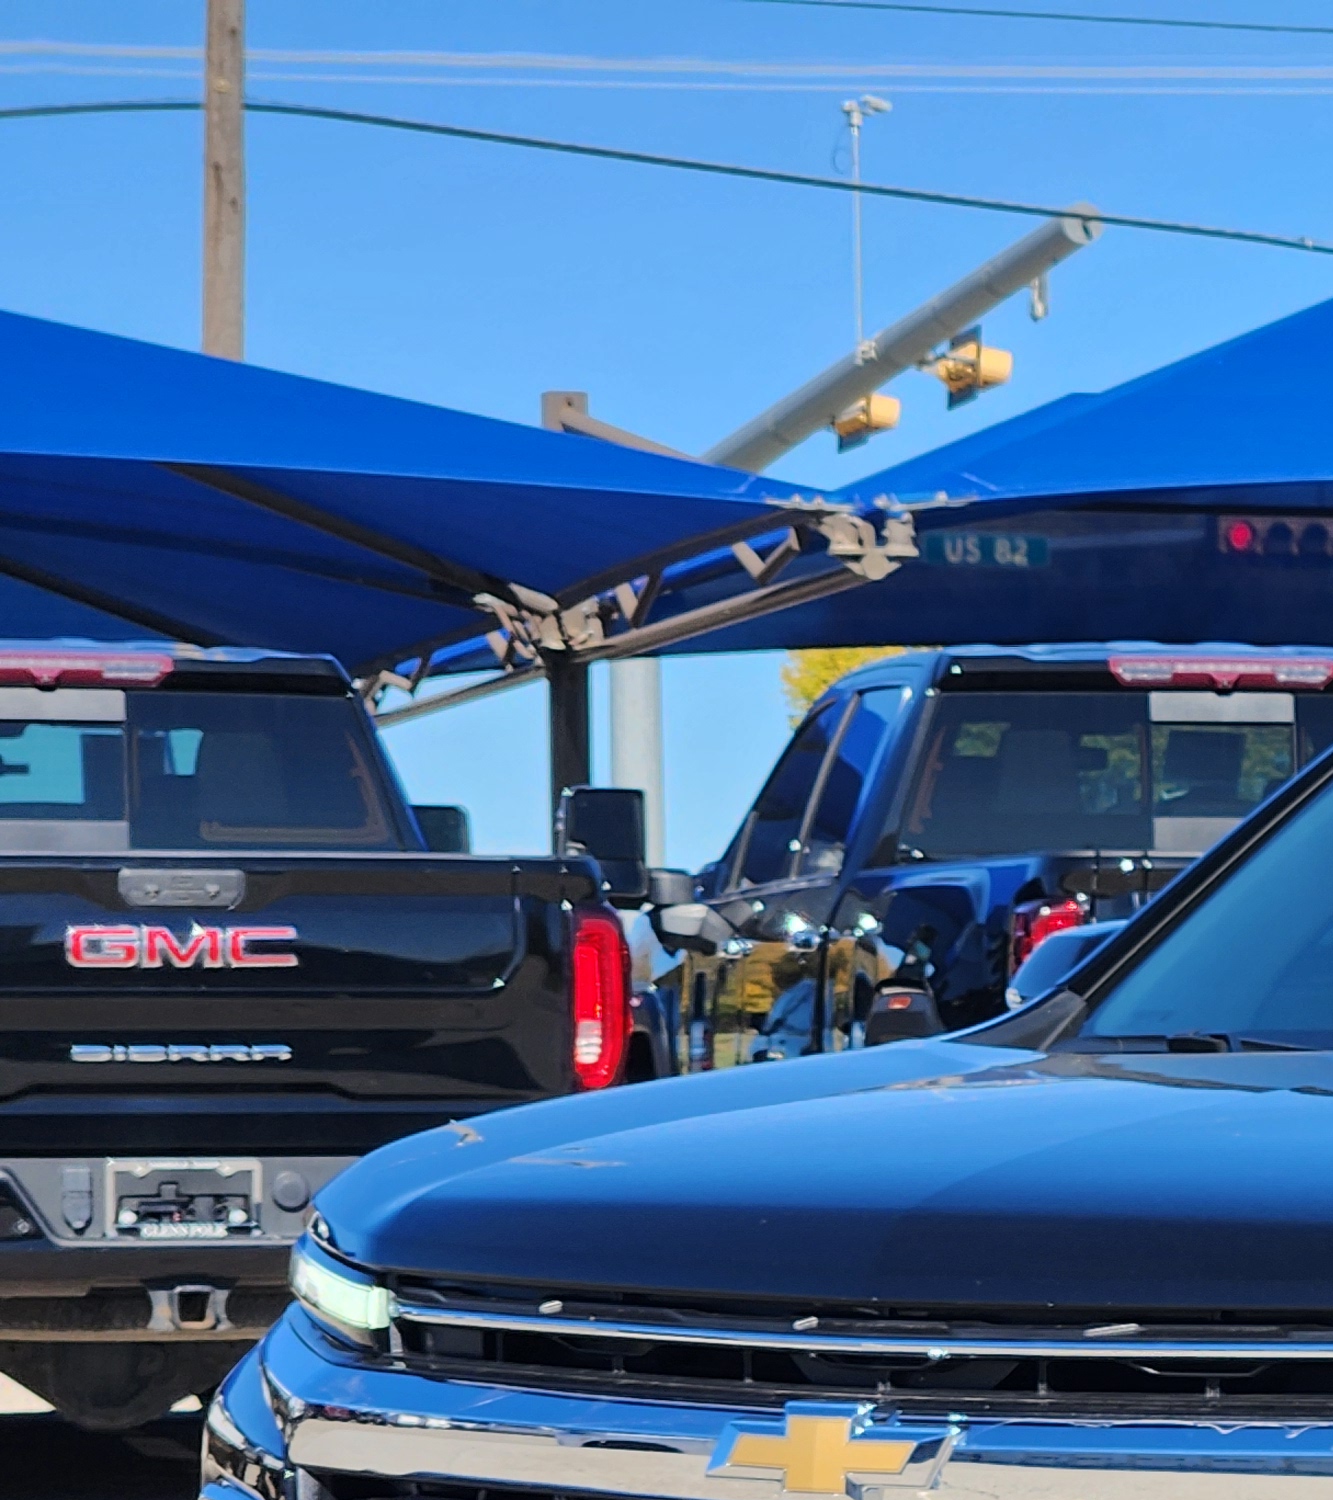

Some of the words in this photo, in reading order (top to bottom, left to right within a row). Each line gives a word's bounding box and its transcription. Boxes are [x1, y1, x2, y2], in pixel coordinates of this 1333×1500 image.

[943, 535, 981, 565] US
[994, 536, 1029, 567] 82
[66, 924, 299, 968] GMC
[70, 1043, 293, 1063] SIERRA
